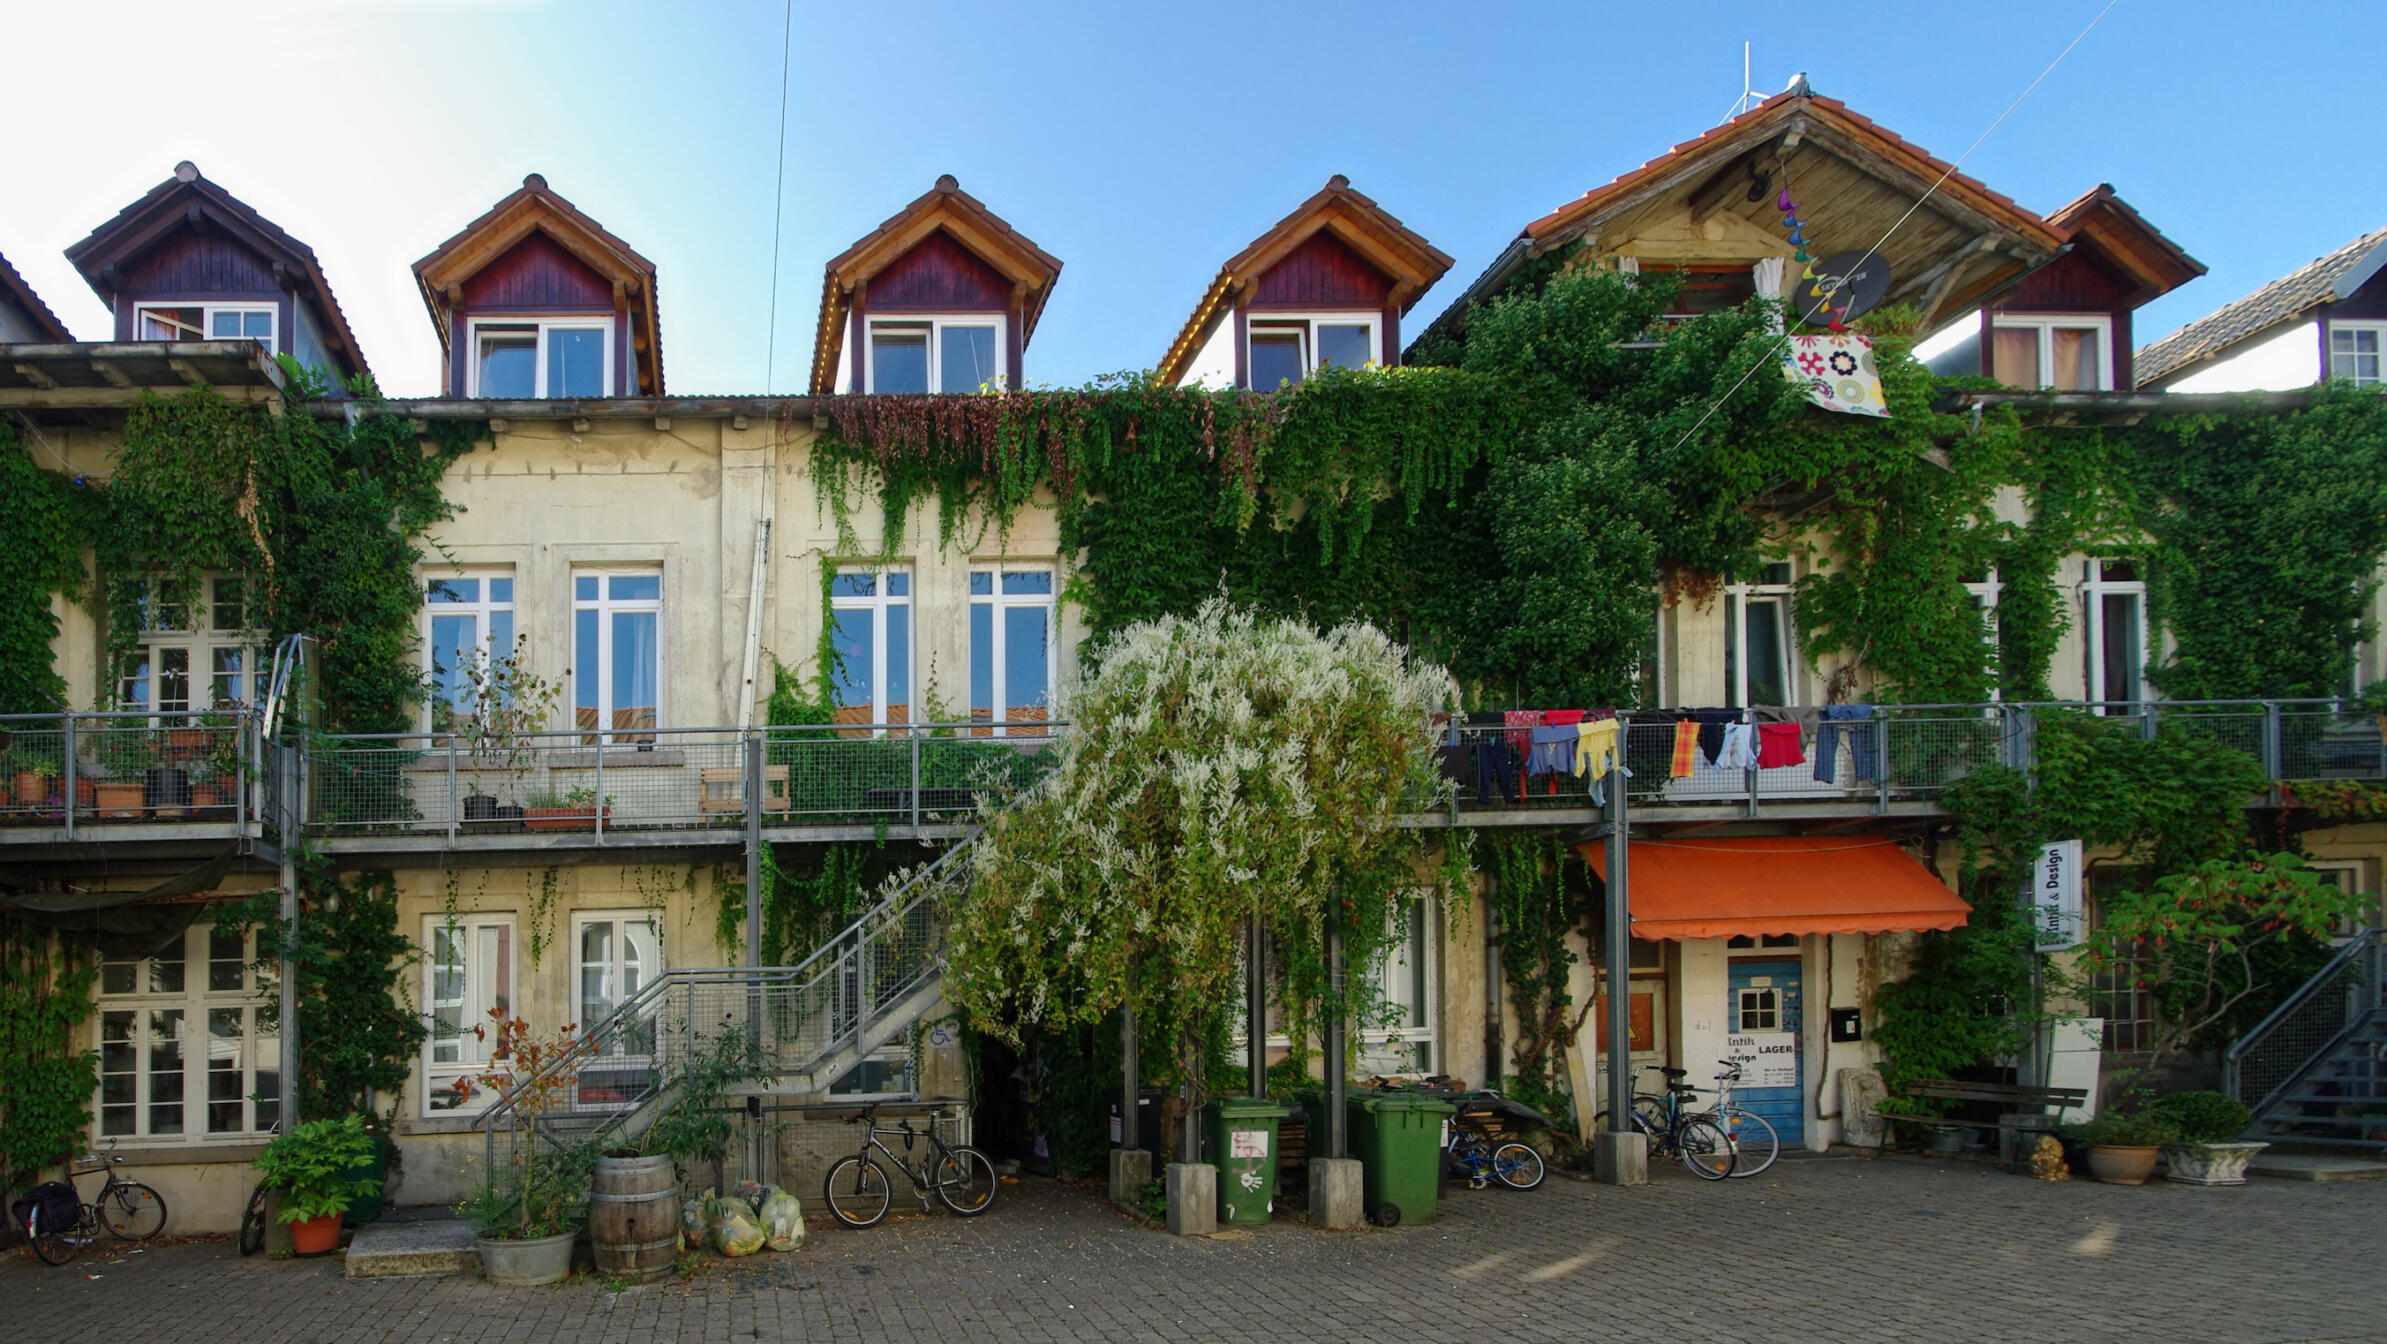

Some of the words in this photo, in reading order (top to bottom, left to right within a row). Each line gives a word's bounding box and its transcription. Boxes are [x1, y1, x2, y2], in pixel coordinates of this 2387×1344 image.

[2046, 848, 2062, 889] Design
[2049, 893, 2059, 901] &
[1759, 1045, 1793, 1054] LAGER
[1728, 1054, 1757, 1063] esign
